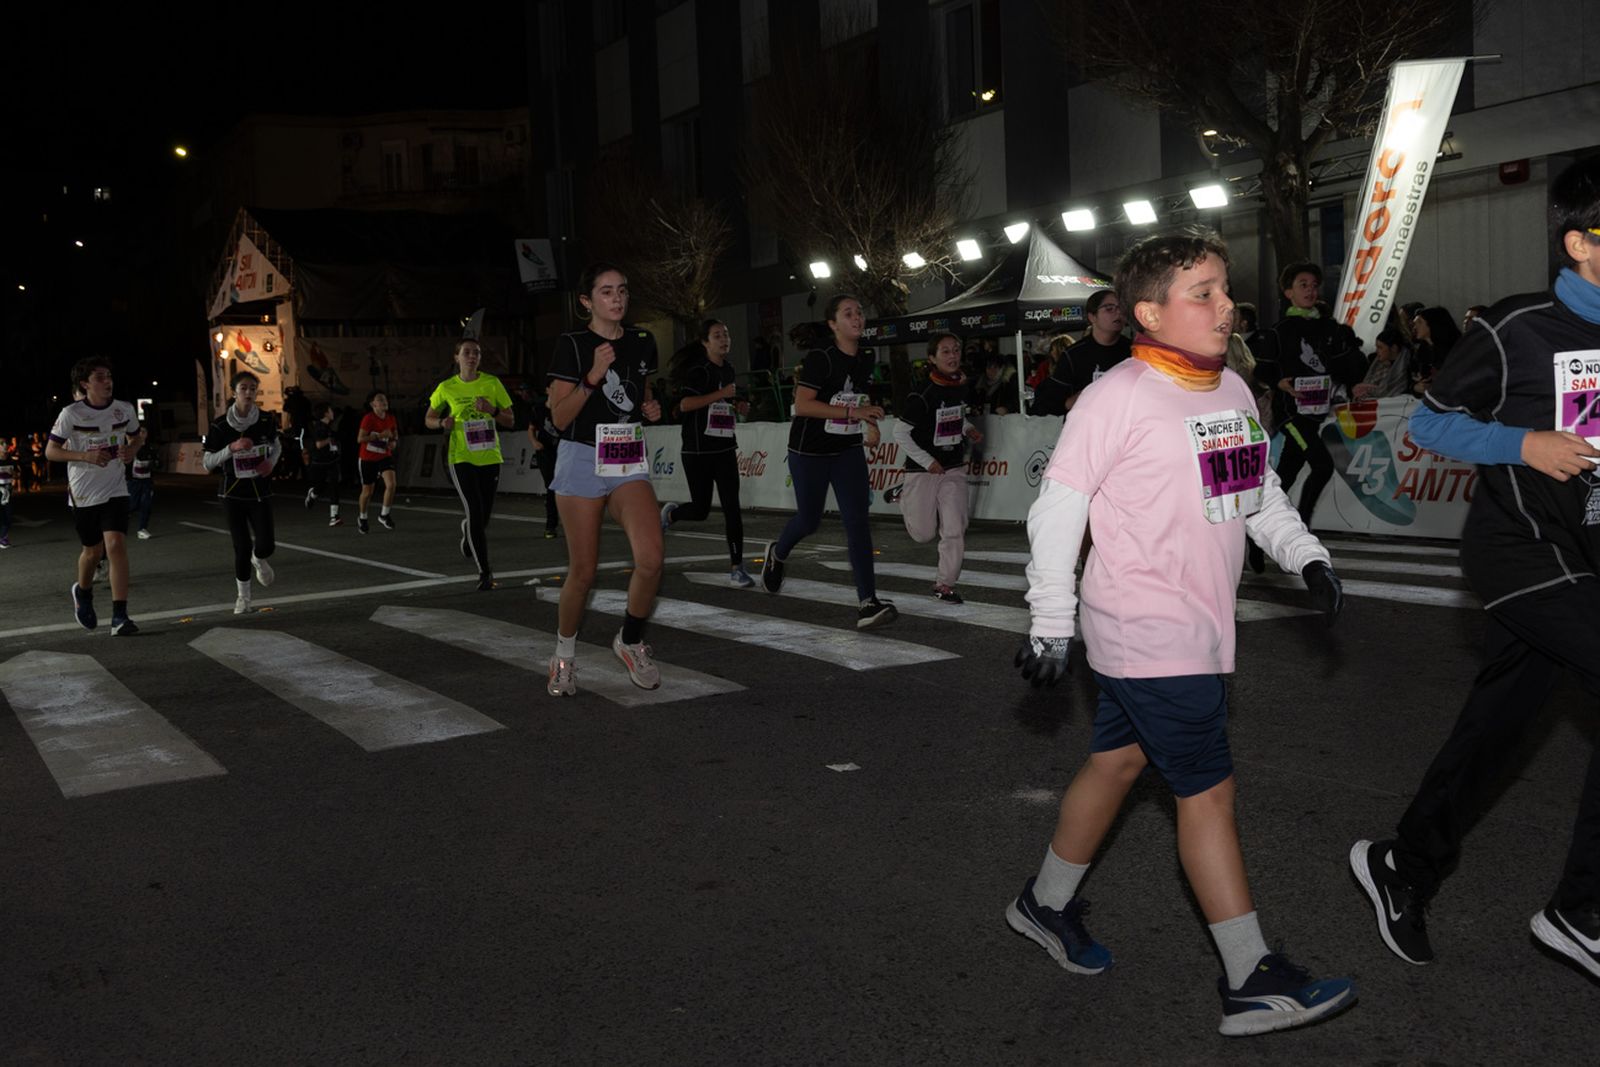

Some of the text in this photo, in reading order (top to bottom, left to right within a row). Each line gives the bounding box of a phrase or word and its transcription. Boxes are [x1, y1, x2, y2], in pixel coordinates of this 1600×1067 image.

[1369, 160, 1429, 324] obras maestras
[1571, 377, 1597, 391] SAN
[611, 390, 624, 404] 43
[1234, 421, 1244, 432] DE
[867, 443, 898, 465] SAN
[1208, 445, 1260, 485] 14165
[1345, 444, 1391, 496] 43
